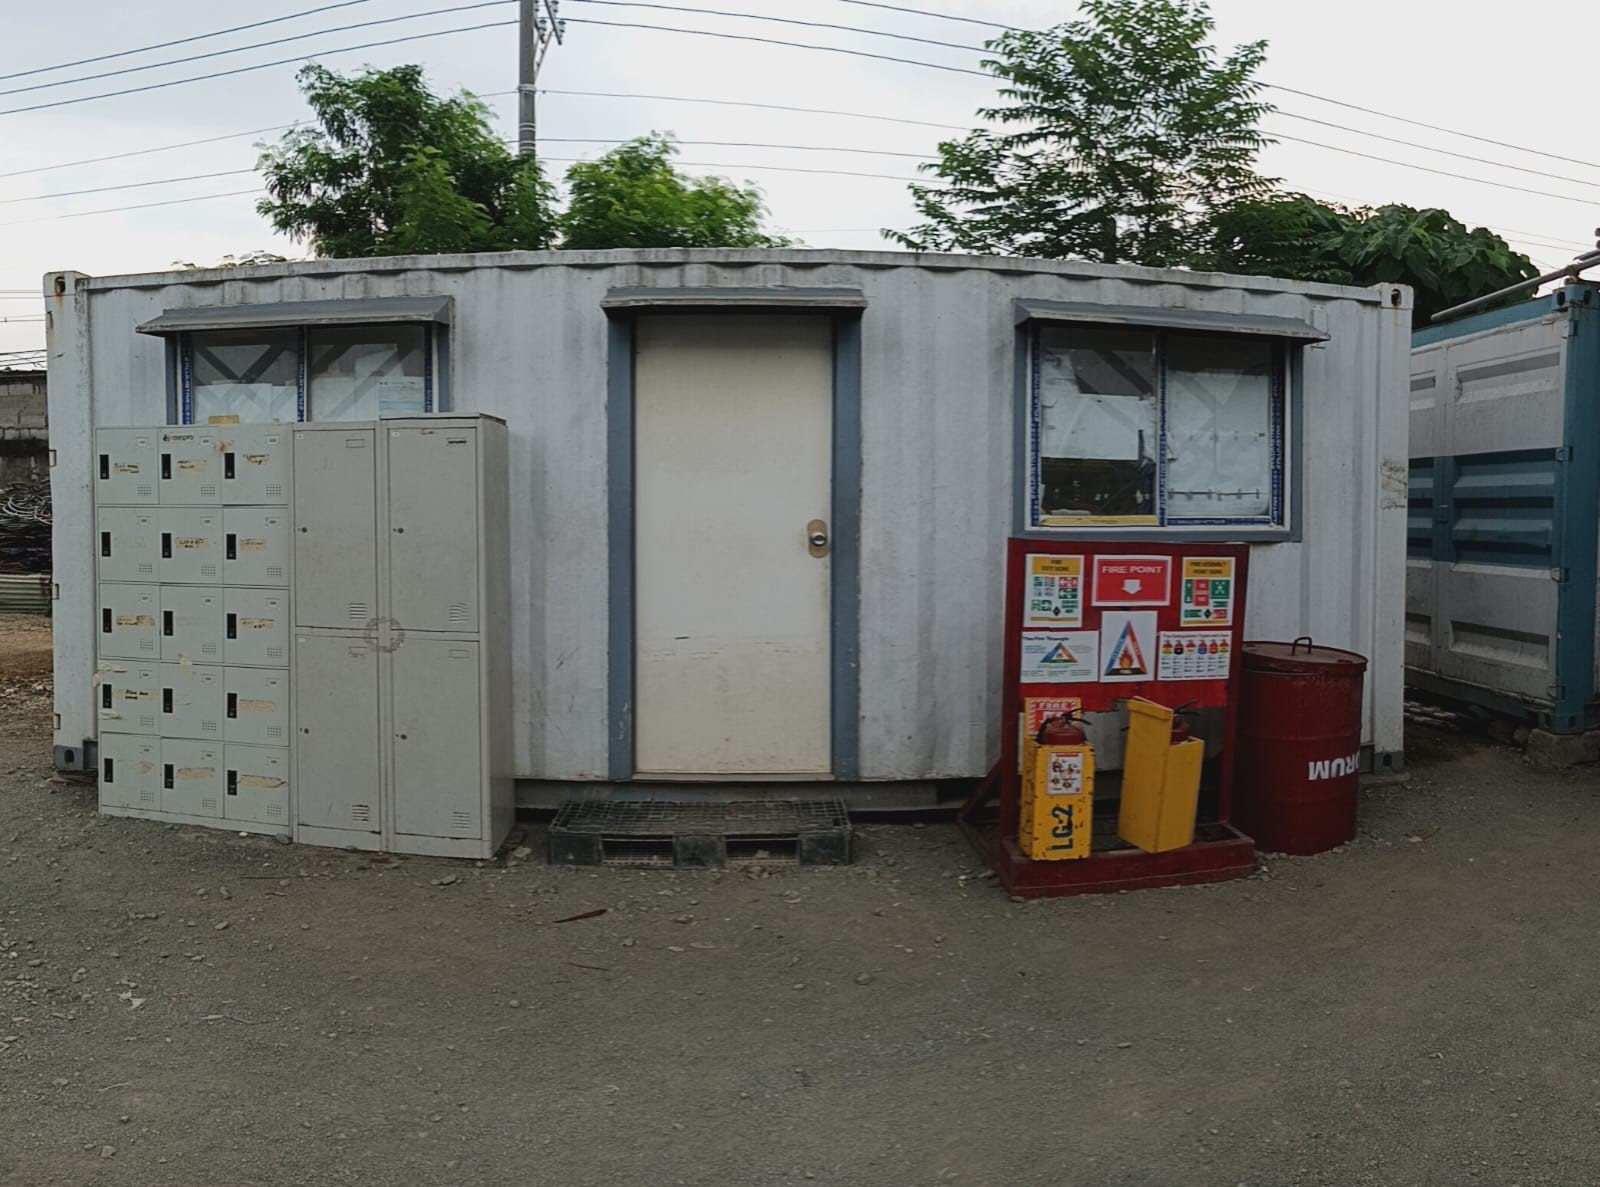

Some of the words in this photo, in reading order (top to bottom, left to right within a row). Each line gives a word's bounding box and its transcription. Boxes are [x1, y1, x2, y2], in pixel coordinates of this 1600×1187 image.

[1101, 565, 1128, 574] FIRE
[1129, 565, 1163, 574] POINT
[1051, 804, 1073, 851] LG-2
